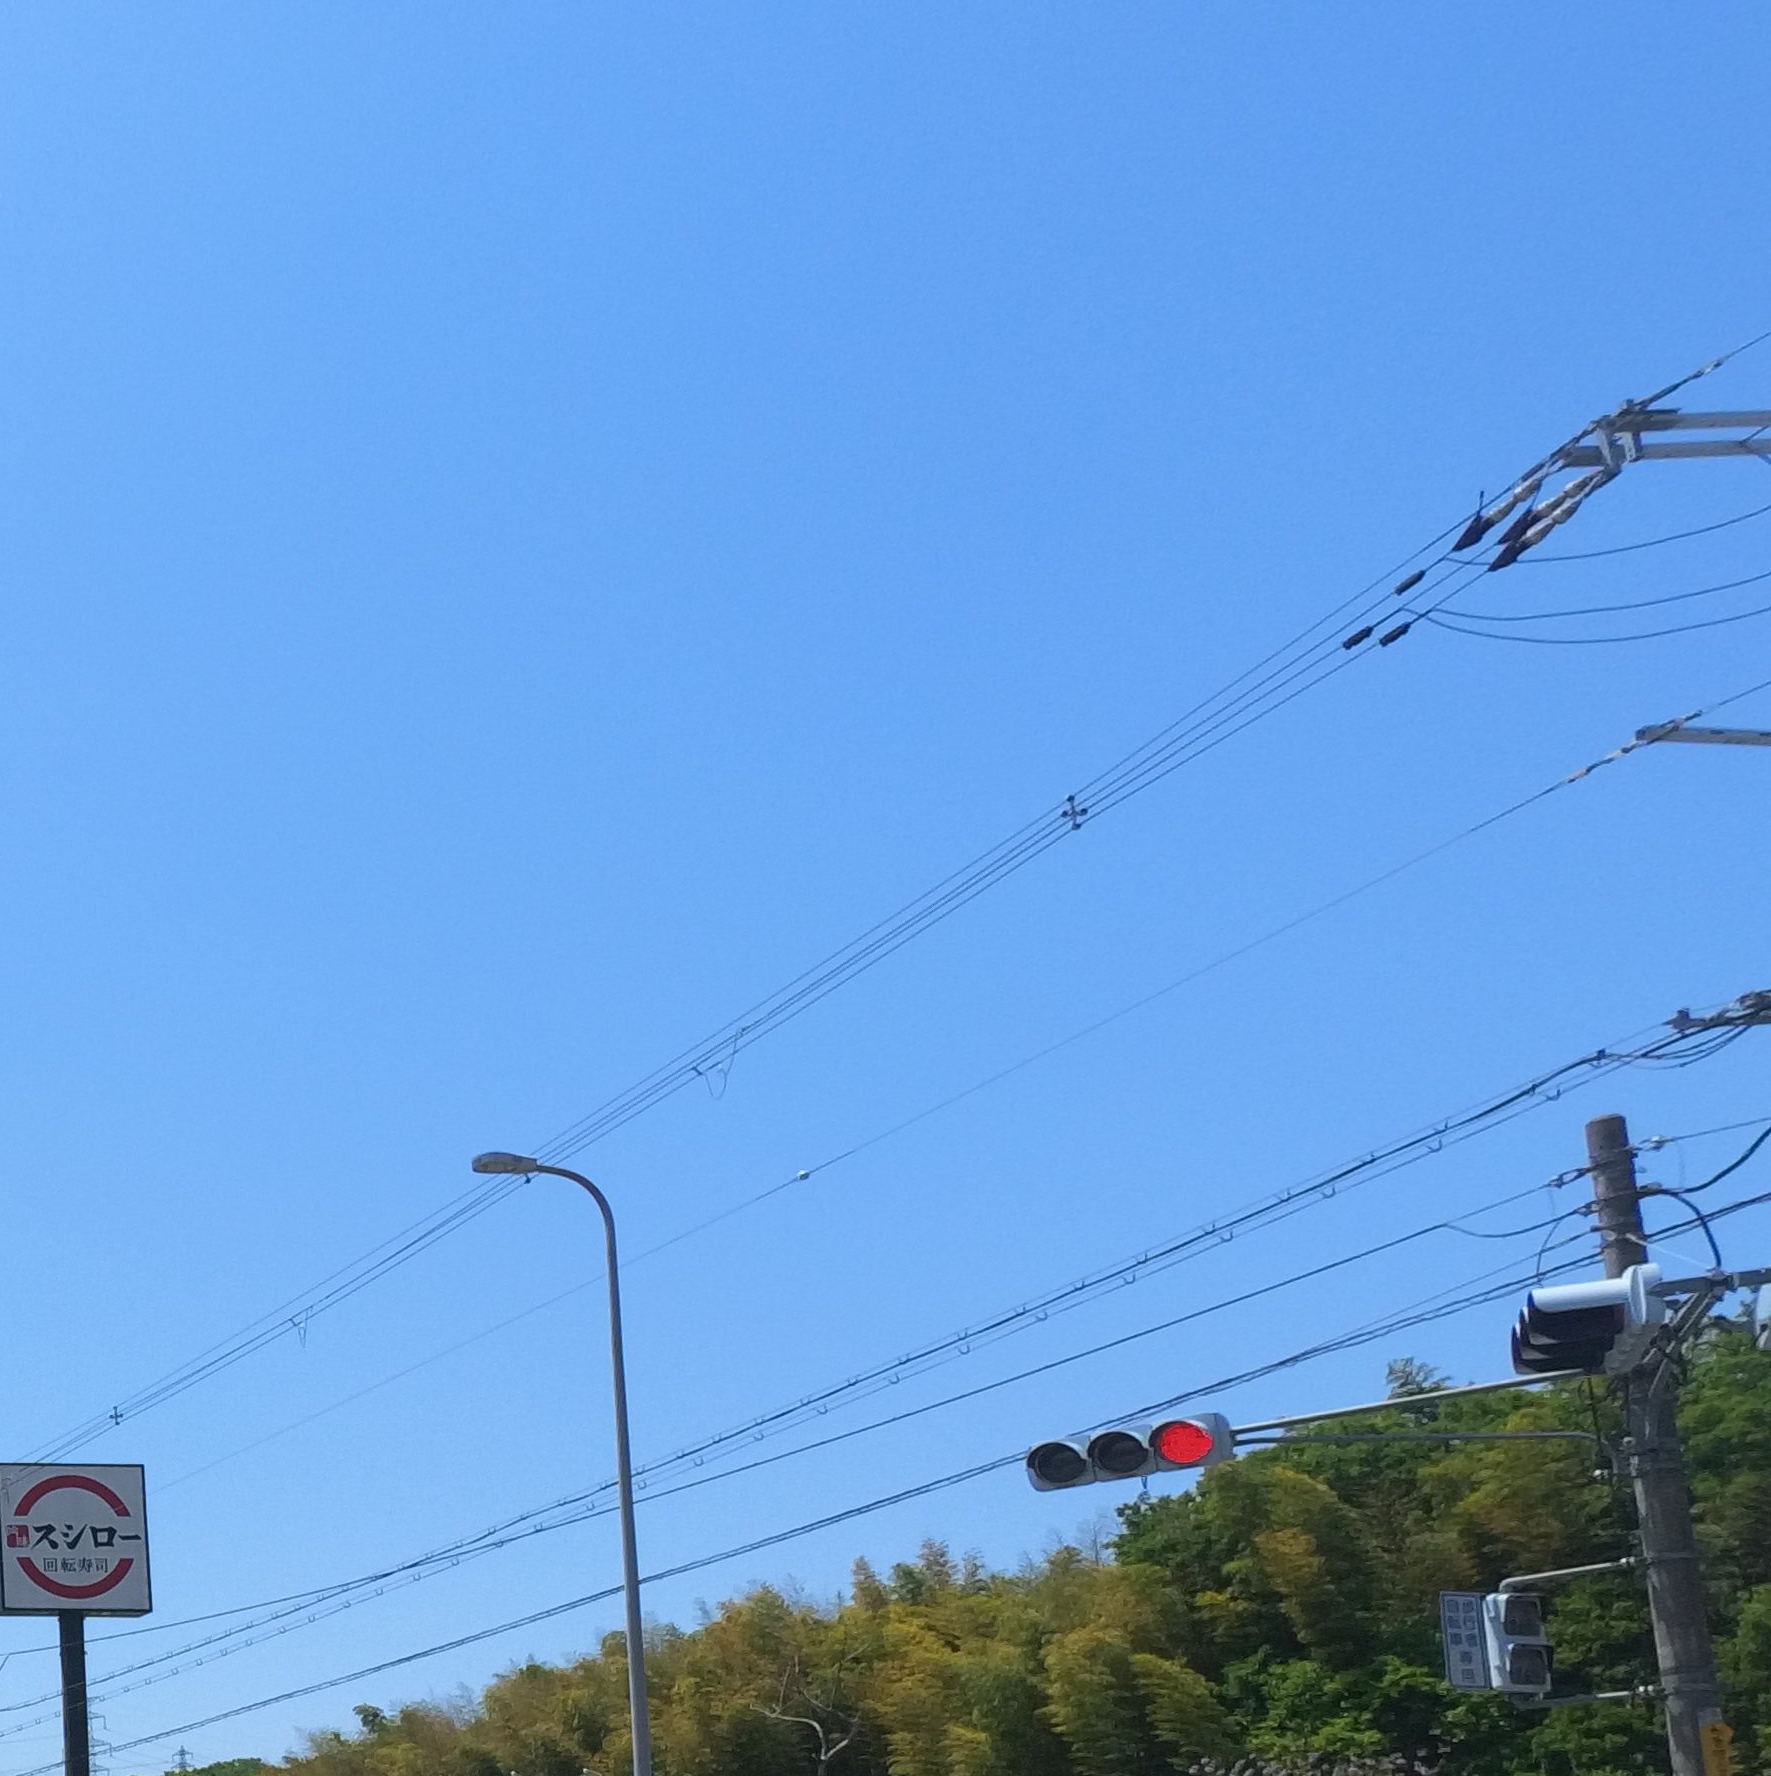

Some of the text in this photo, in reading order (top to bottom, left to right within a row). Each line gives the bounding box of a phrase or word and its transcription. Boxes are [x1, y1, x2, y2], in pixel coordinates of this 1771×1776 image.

[31, 1523, 142, 1550] スシロー
[43, 1557, 108, 1573] 回転寿司
